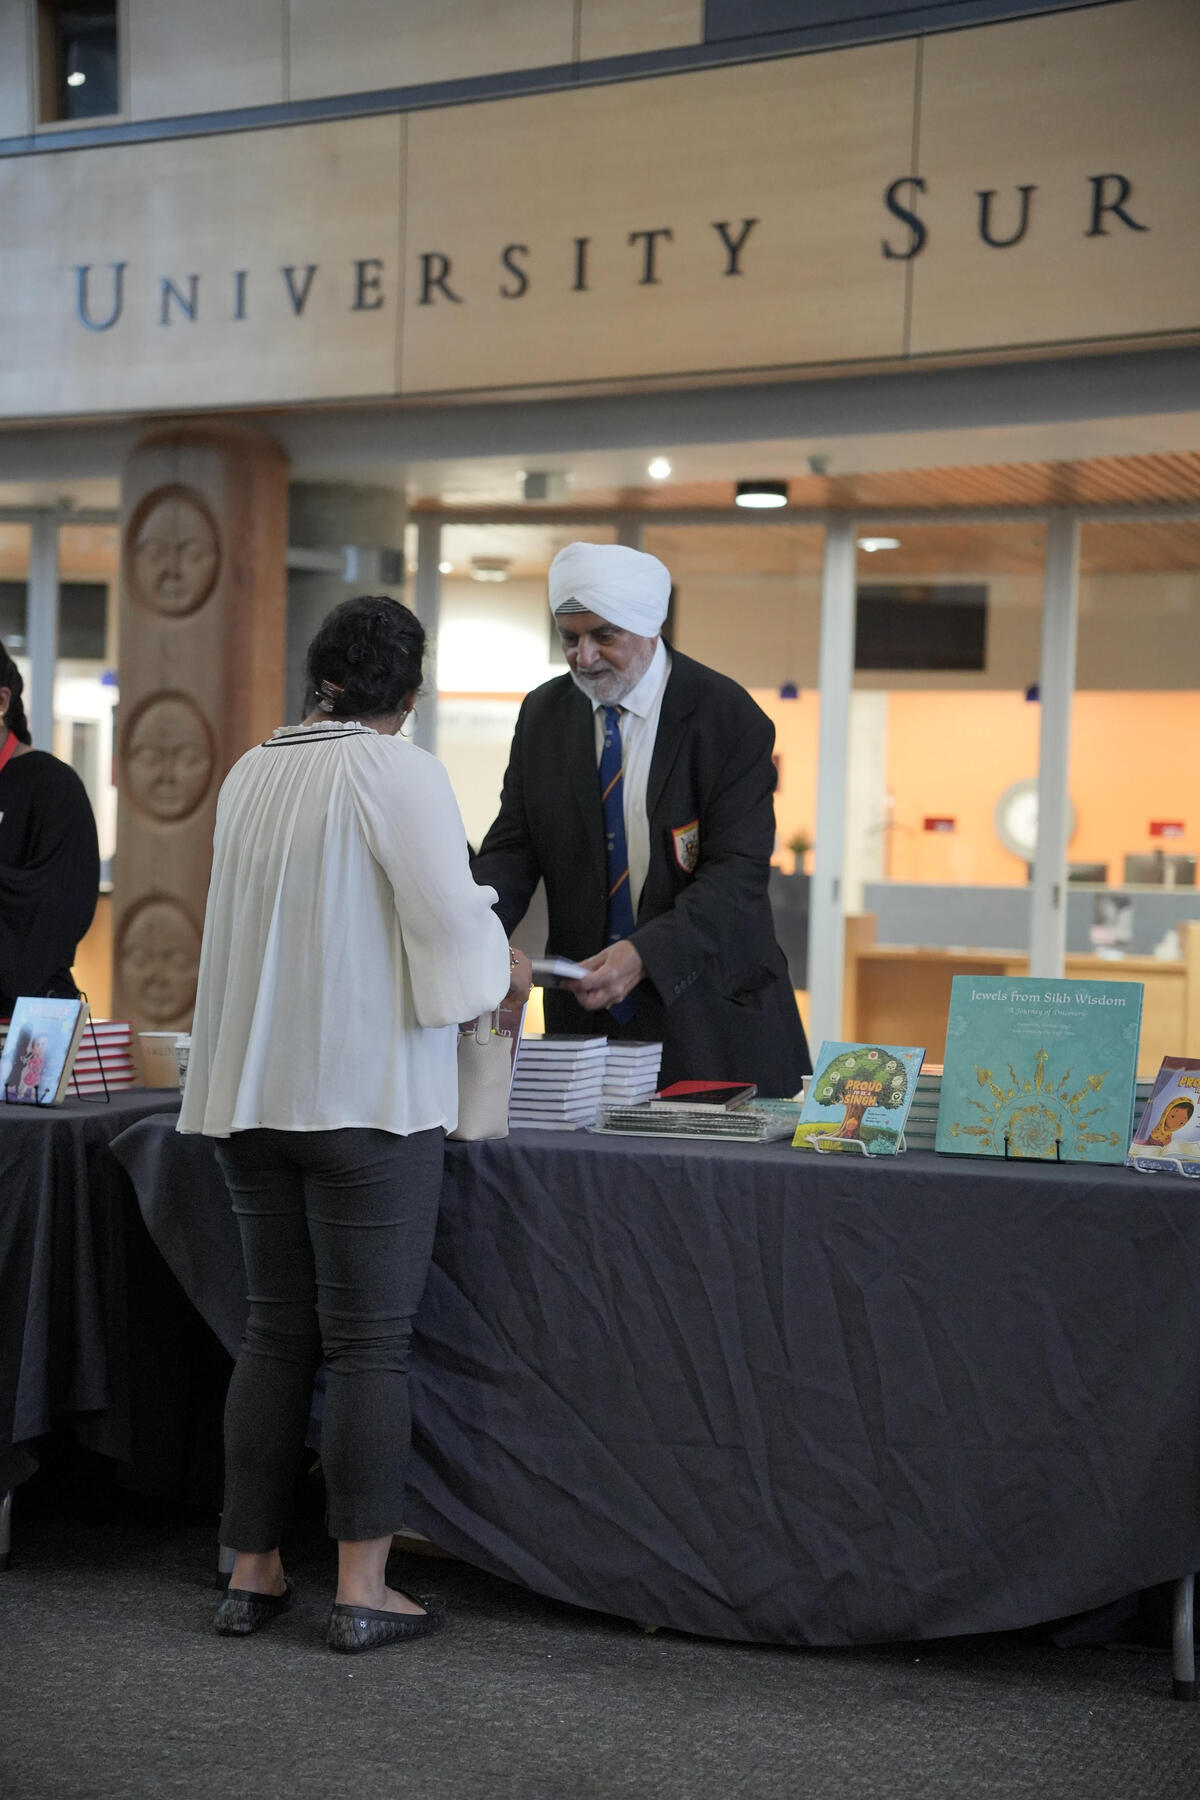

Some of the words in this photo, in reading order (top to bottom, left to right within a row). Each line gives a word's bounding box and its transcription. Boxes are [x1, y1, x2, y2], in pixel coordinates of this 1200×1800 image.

[74, 217, 760, 332] UNIVERSITY
[881, 172, 1150, 261] SUR
[971, 990, 1008, 1001] Jewels
[1010, 991, 1040, 1002] from
[1044, 992, 1071, 1004] Sikh
[1075, 993, 1126, 1007] Wisdom
[845, 1079, 883, 1092] PROUD
[843, 1094, 877, 1107] SINGH
